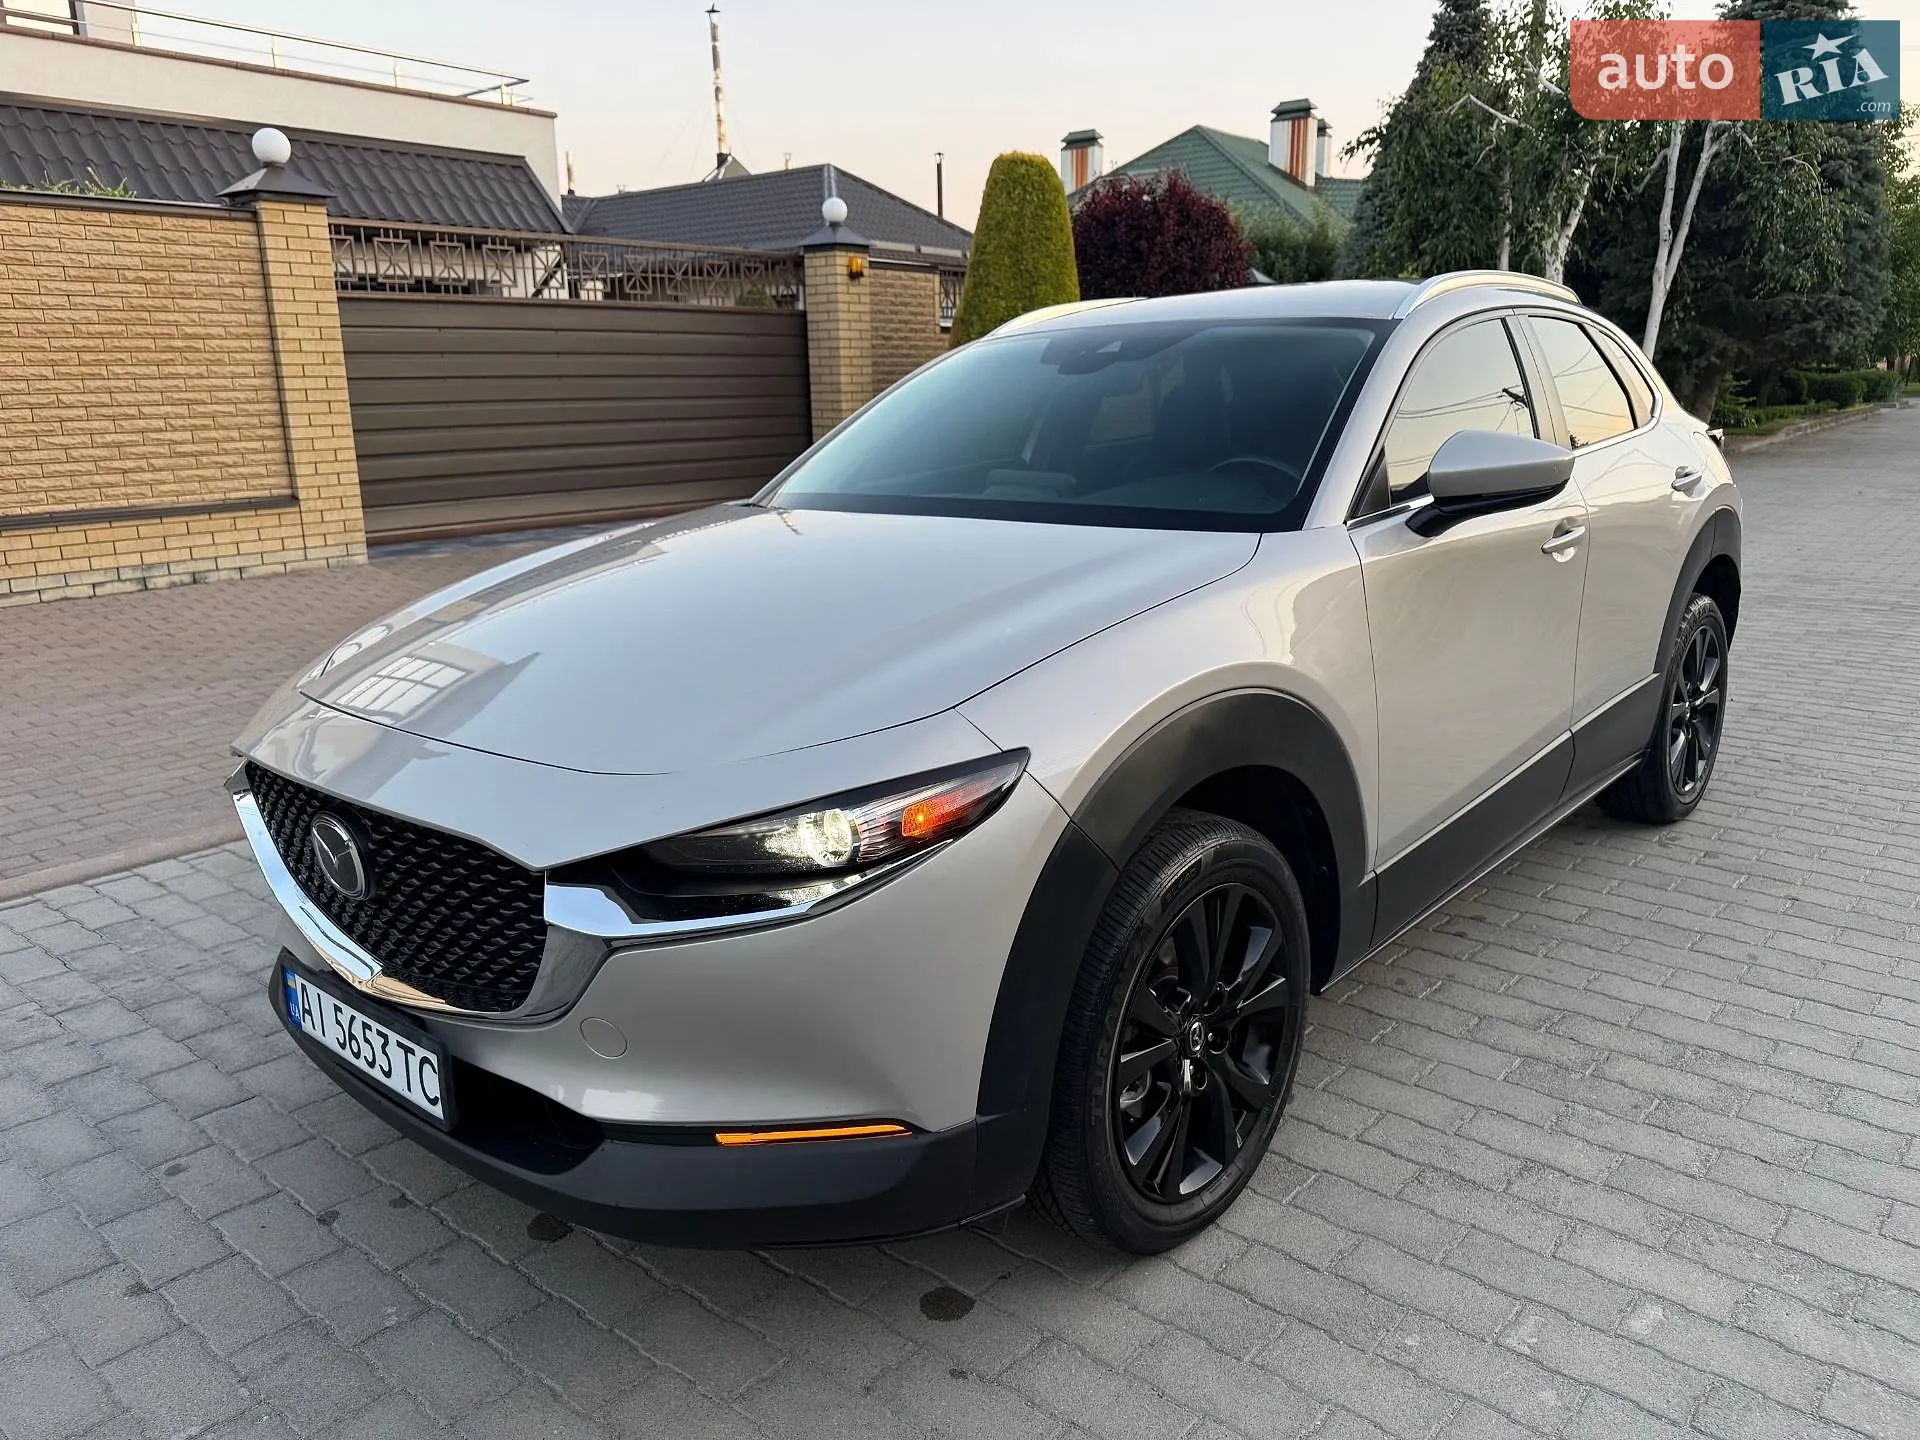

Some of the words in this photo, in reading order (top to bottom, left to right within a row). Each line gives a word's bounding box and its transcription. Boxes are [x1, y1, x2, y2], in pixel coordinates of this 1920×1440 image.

[289, 1001, 301, 1020] UA
[300, 982, 326, 1039] AI
[333, 1002, 392, 1079] 5653
[395, 1039, 440, 1107] TC
